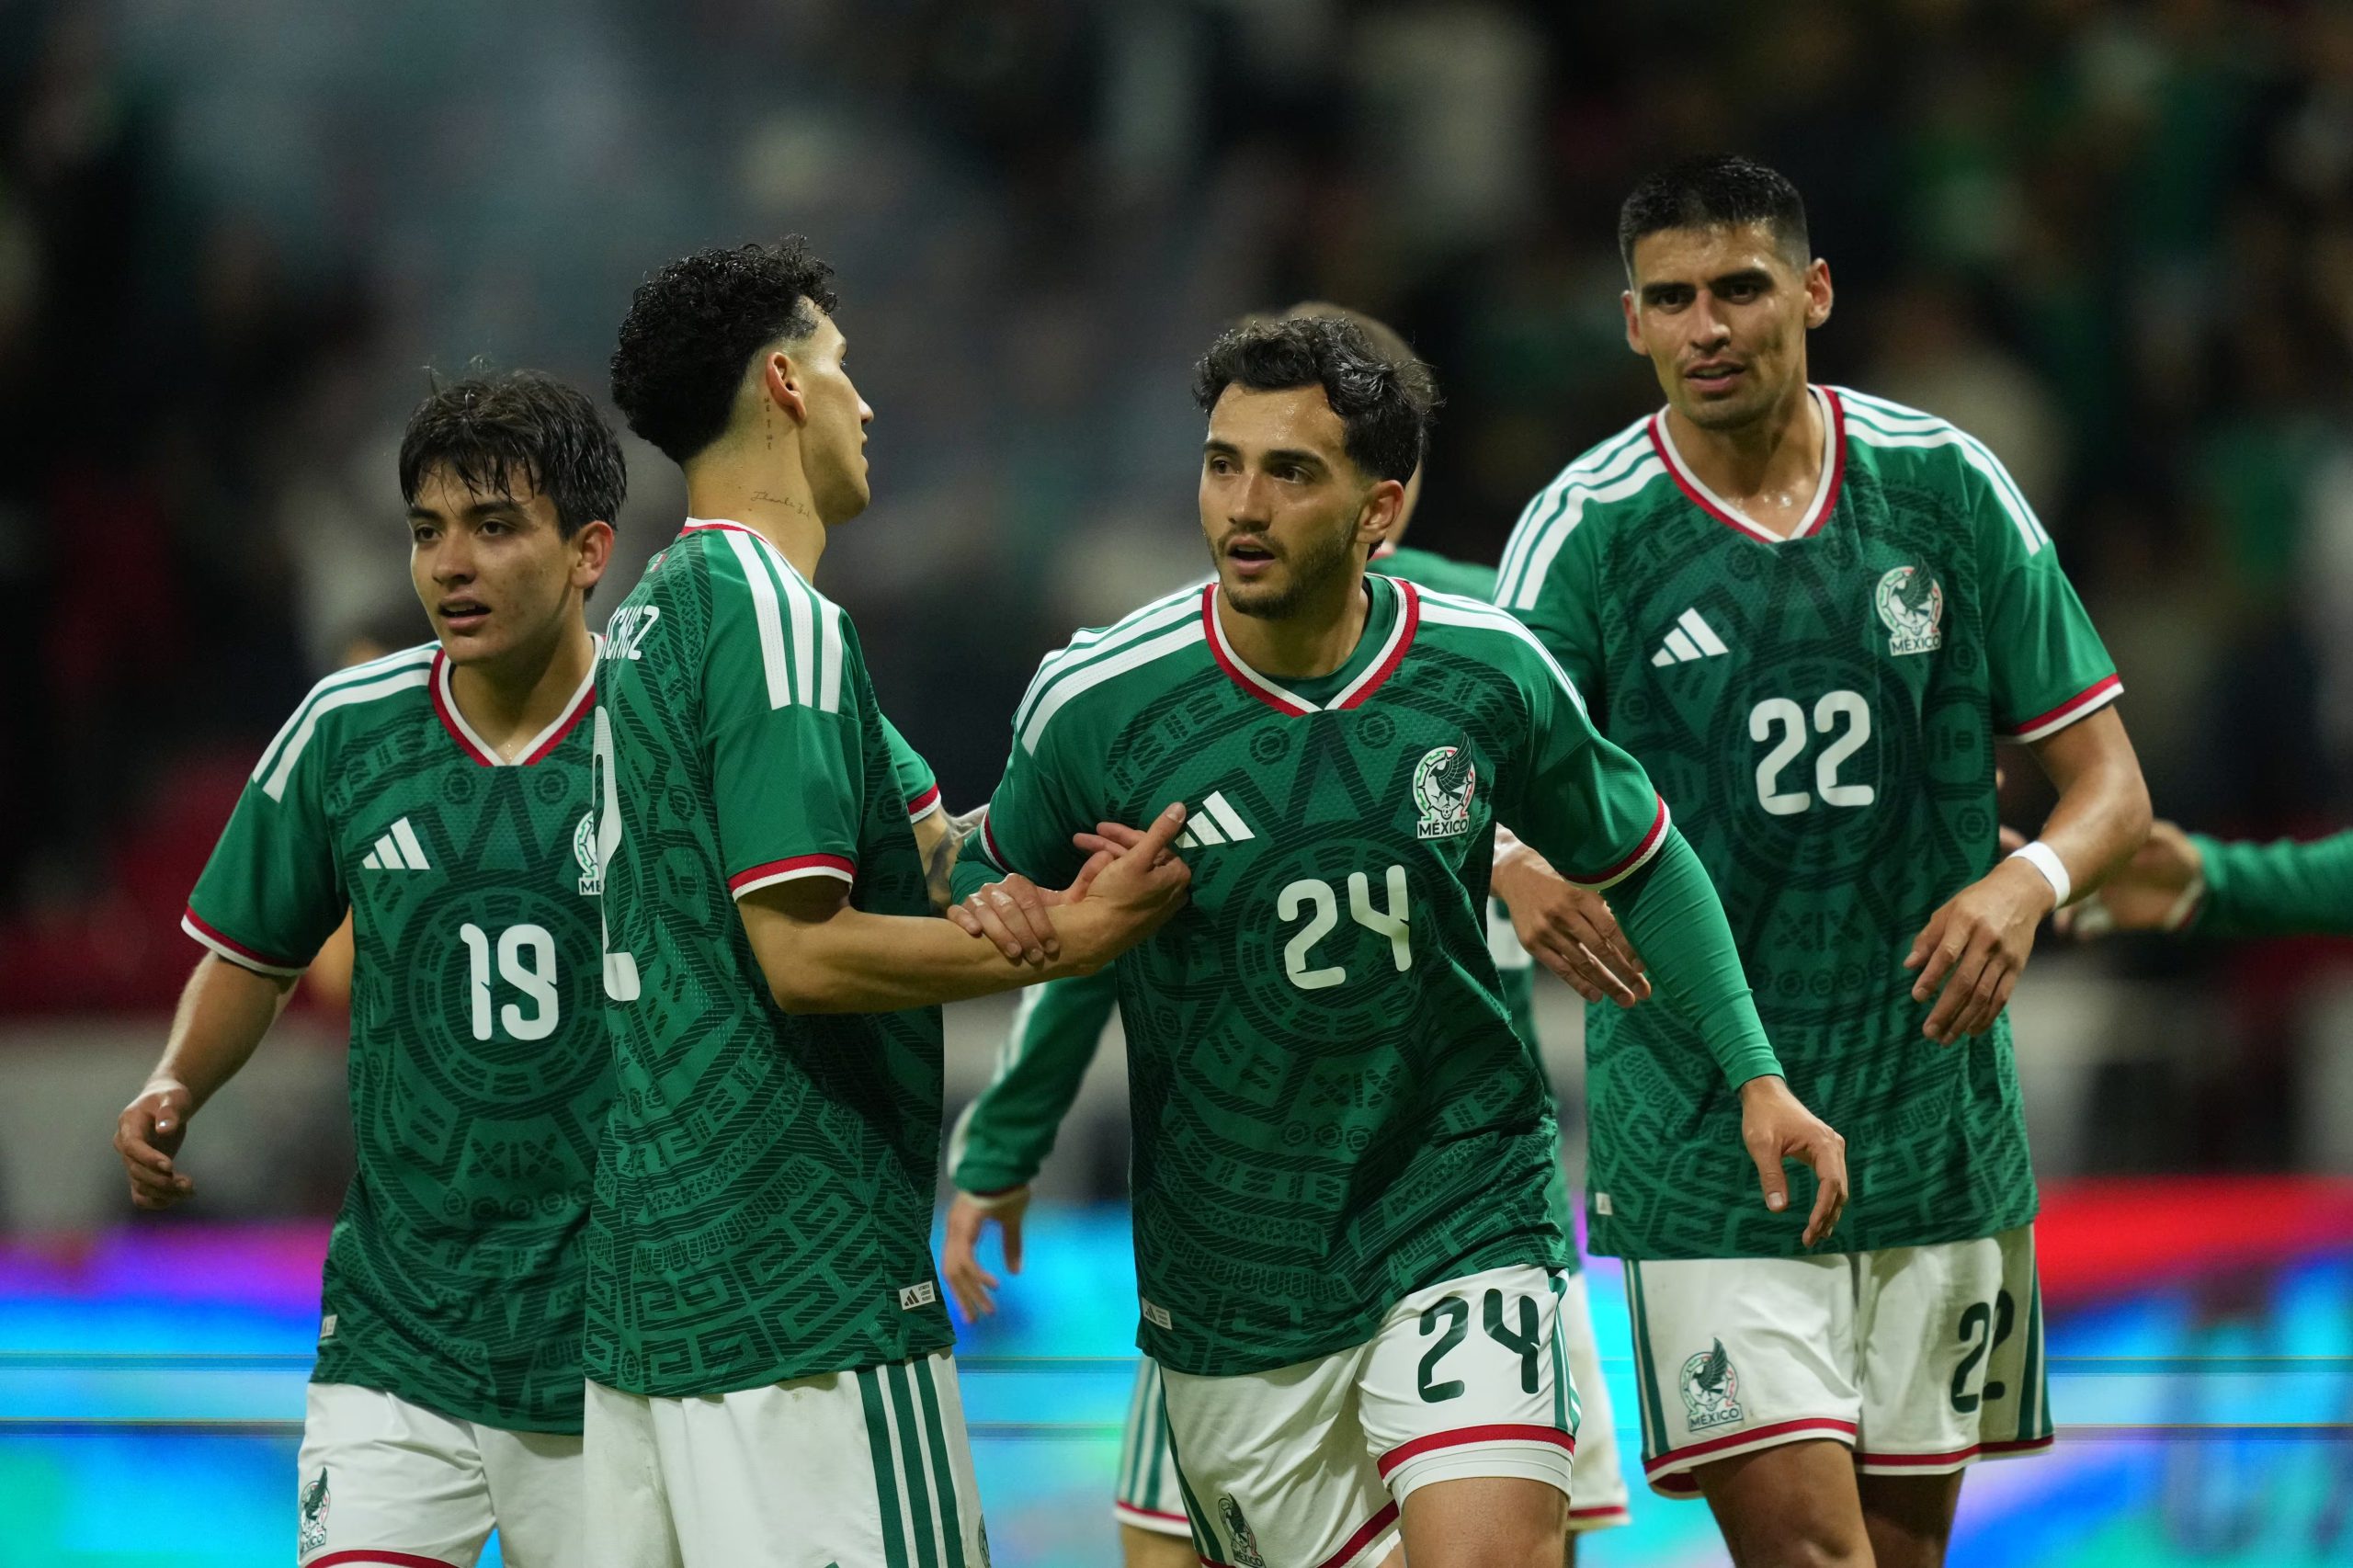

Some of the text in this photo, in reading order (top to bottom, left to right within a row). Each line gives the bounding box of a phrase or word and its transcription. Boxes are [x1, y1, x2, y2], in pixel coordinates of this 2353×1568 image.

[1892, 634, 1940, 653] MÉXICO
[1749, 689, 1875, 816] 22
[1418, 819, 1468, 836] MÉXICO
[460, 923, 559, 1040] 19
[1277, 864, 1413, 990] 24
[1417, 1288, 1540, 1404] 24
[1950, 1289, 2016, 1414] 22
